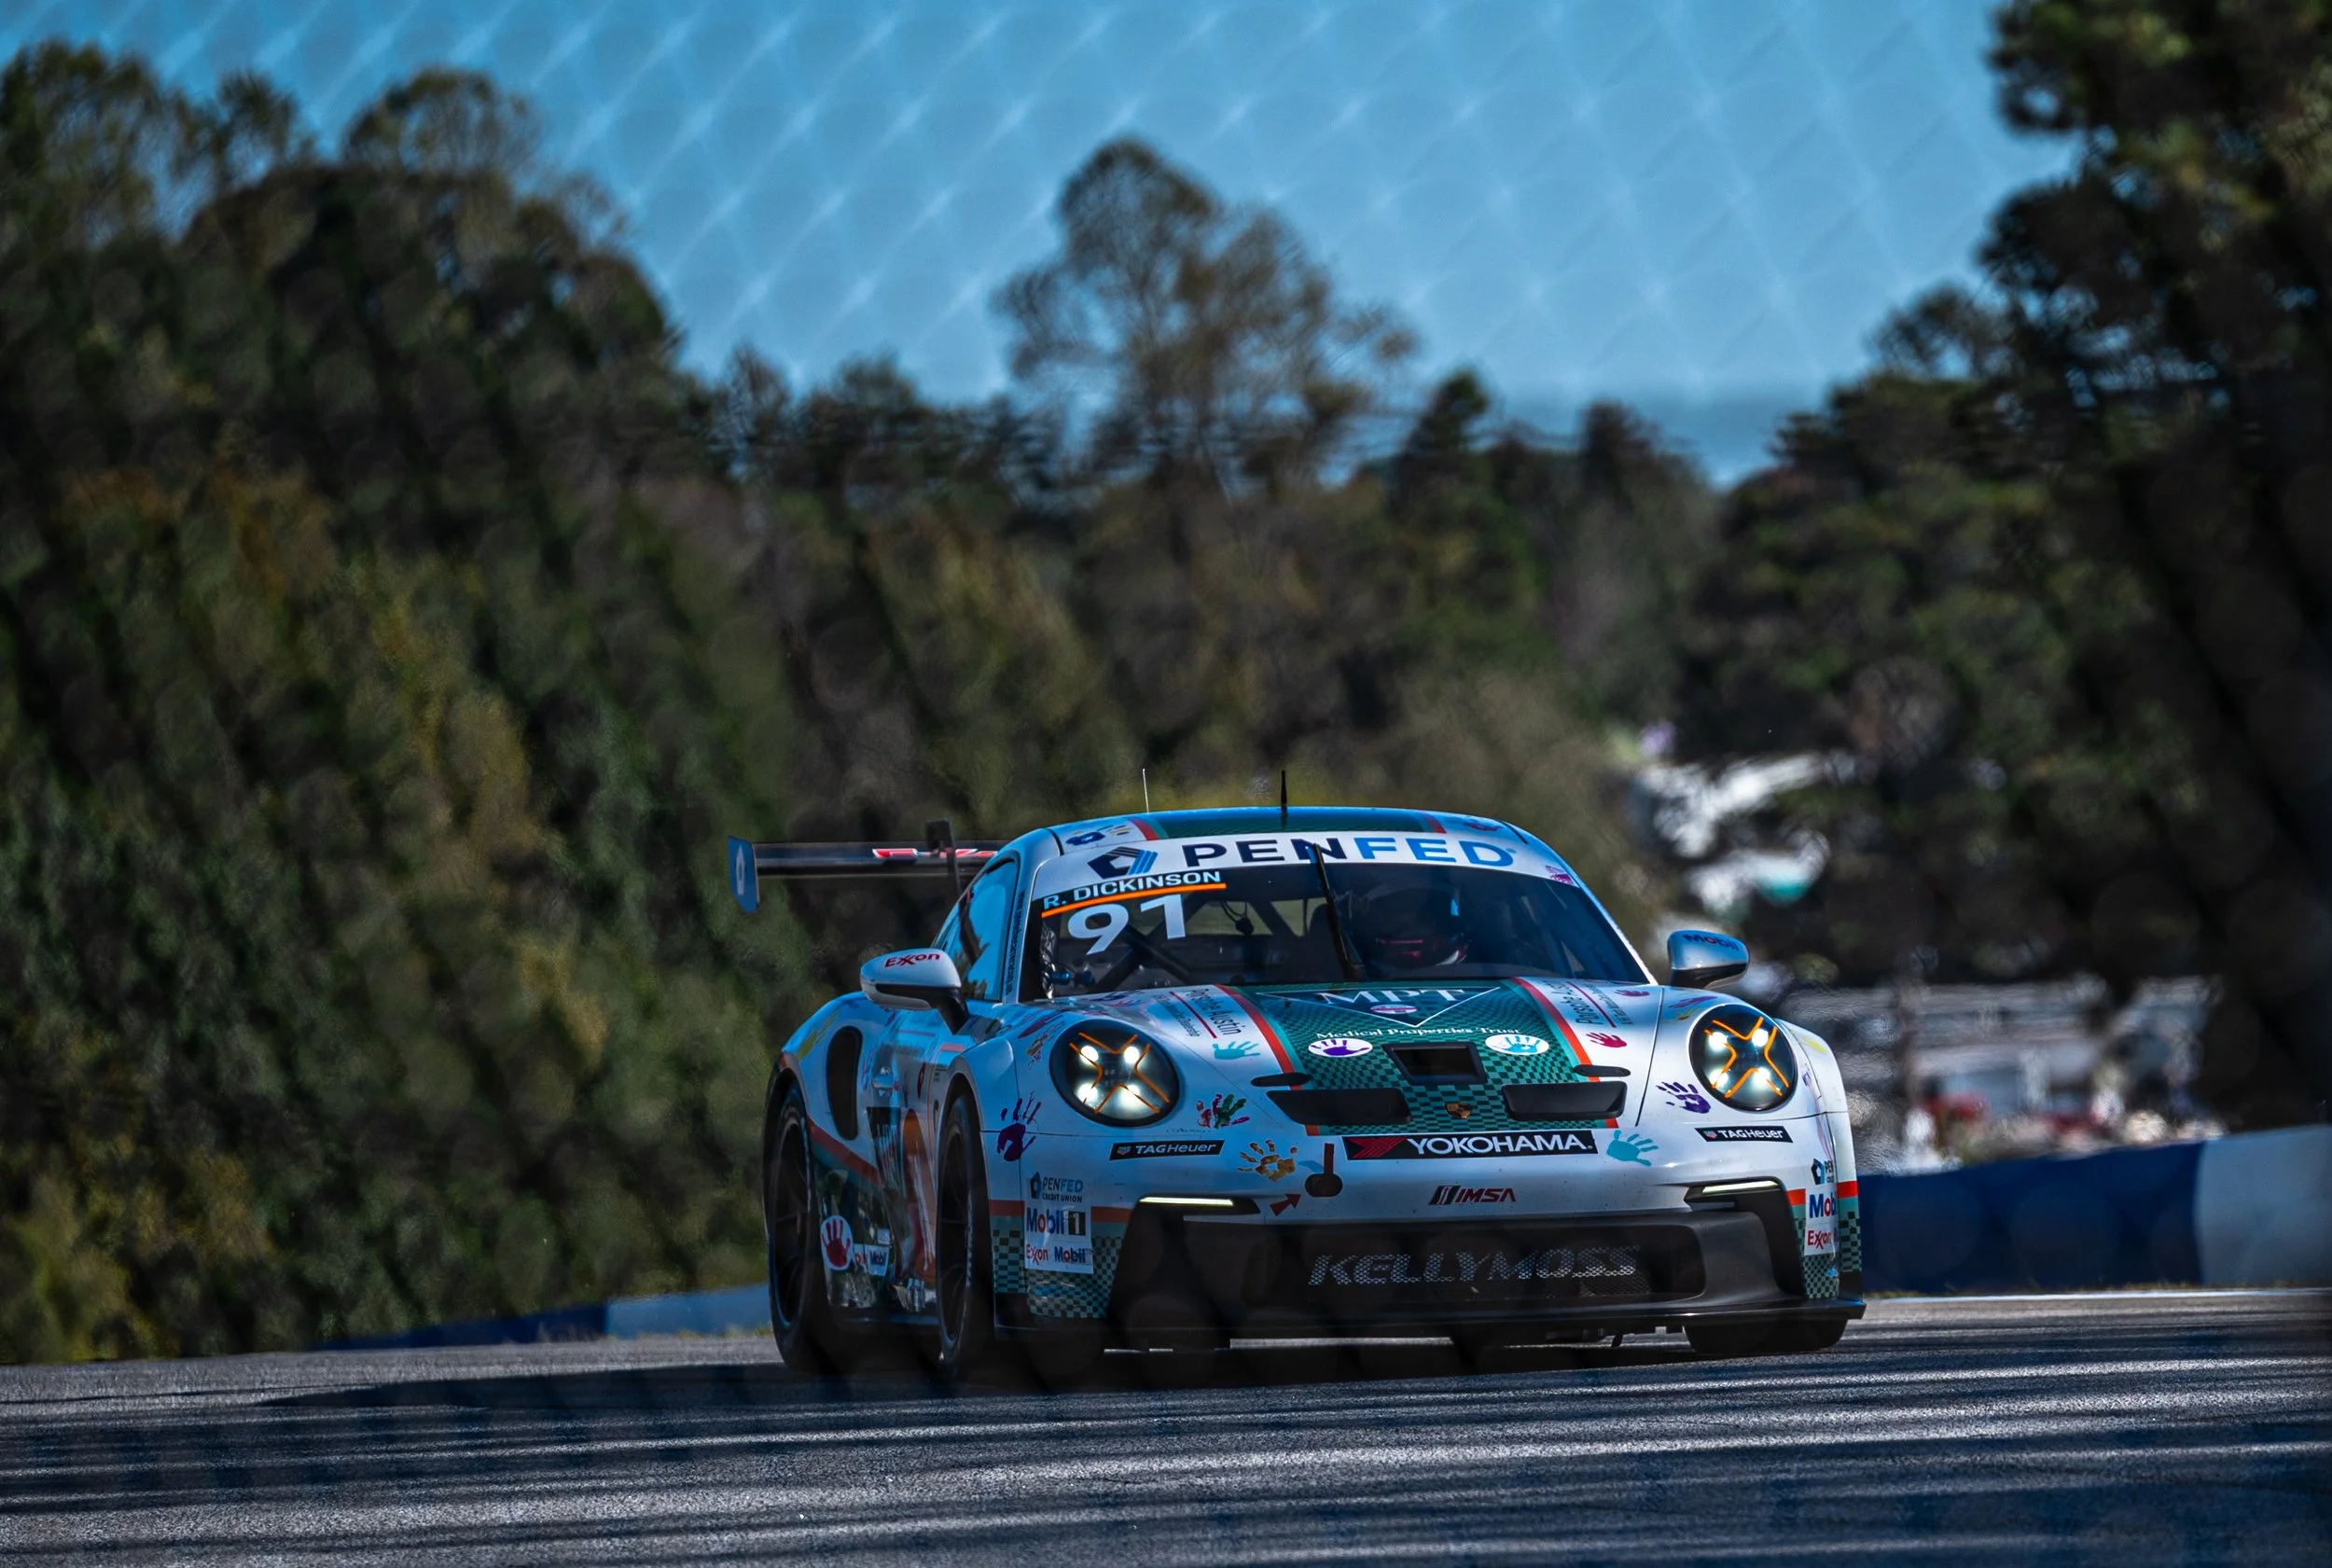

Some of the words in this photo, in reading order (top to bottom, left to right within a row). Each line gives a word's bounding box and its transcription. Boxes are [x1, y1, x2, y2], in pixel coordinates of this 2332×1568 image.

[1182, 837, 1514, 867] PENFED
[1044, 895, 1067, 910] R.
[1074, 871, 1222, 900] DICKINSON
[1068, 894, 1187, 956] 91
[1682, 934, 1740, 951] Mobil
[884, 951, 940, 967] Exxon
[1314, 989, 1466, 1005] MPT
[1206, 1011, 1247, 1035] Austin
[1316, 1028, 1382, 1039] Medical
[1386, 1026, 1471, 1037] Properties
[1477, 1026, 1522, 1035] Trust
[1406, 1134, 1588, 1155] YOKOHAMA
[1042, 1176, 1084, 1193] PENFED
[1454, 1187, 1517, 1203] IMSA
[1042, 1193, 1061, 1201] CREDIT
[1061, 1194, 1083, 1203] UNION
[1810, 1192, 1837, 1219] Mob
[1026, 1207, 1064, 1235] Mobil
[1026, 1243, 1049, 1266] Exxon
[1054, 1246, 1086, 1264] Mobil
